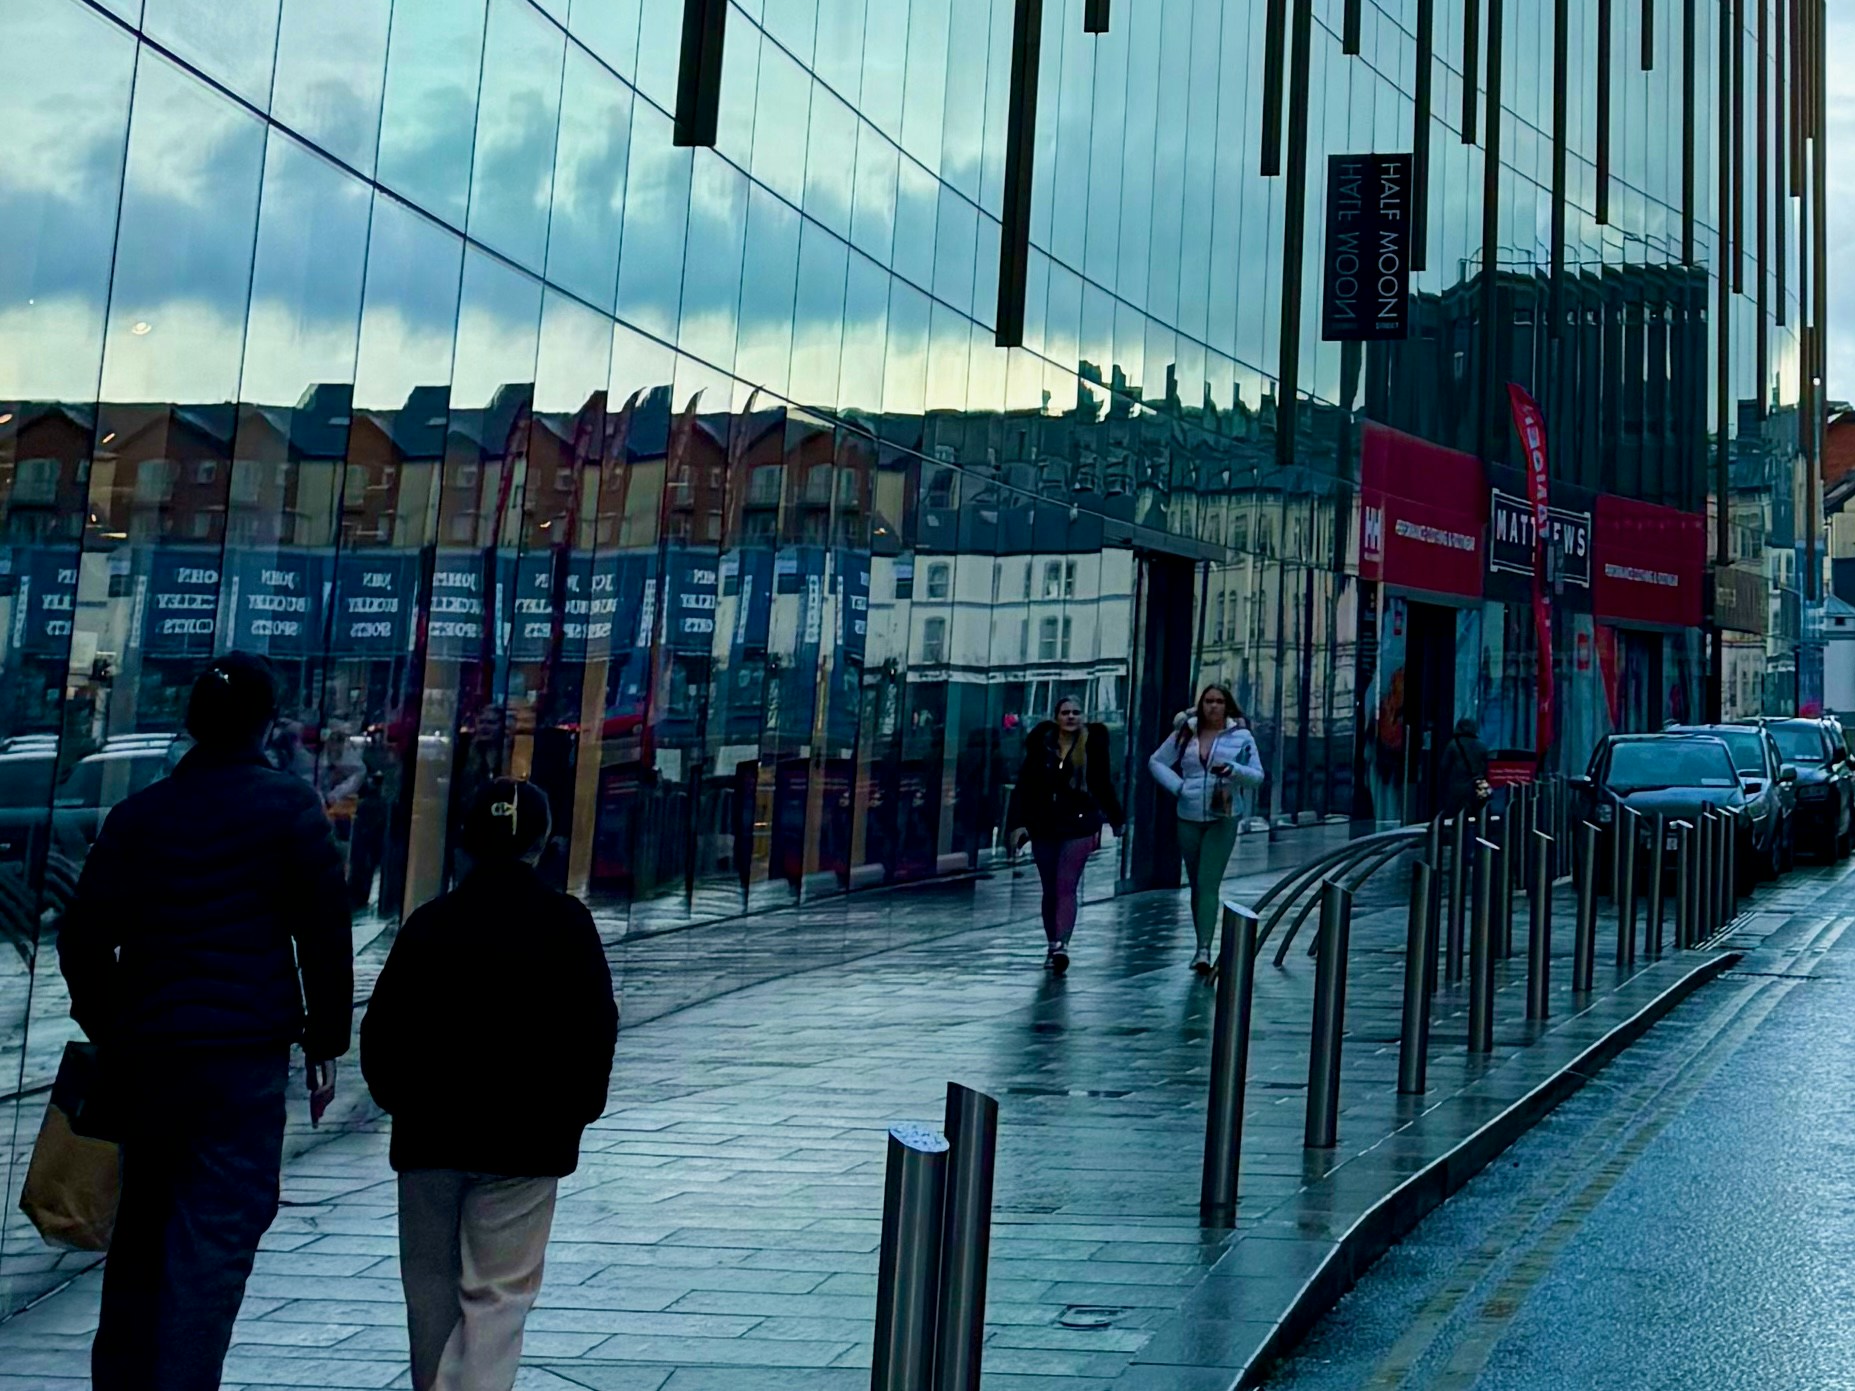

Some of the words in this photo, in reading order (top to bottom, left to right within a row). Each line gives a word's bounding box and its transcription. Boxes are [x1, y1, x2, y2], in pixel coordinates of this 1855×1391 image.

[1379, 163, 1402, 221] HALF
[1377, 231, 1400, 318] MOON
[1496, 508, 1586, 557] MATTEWS
